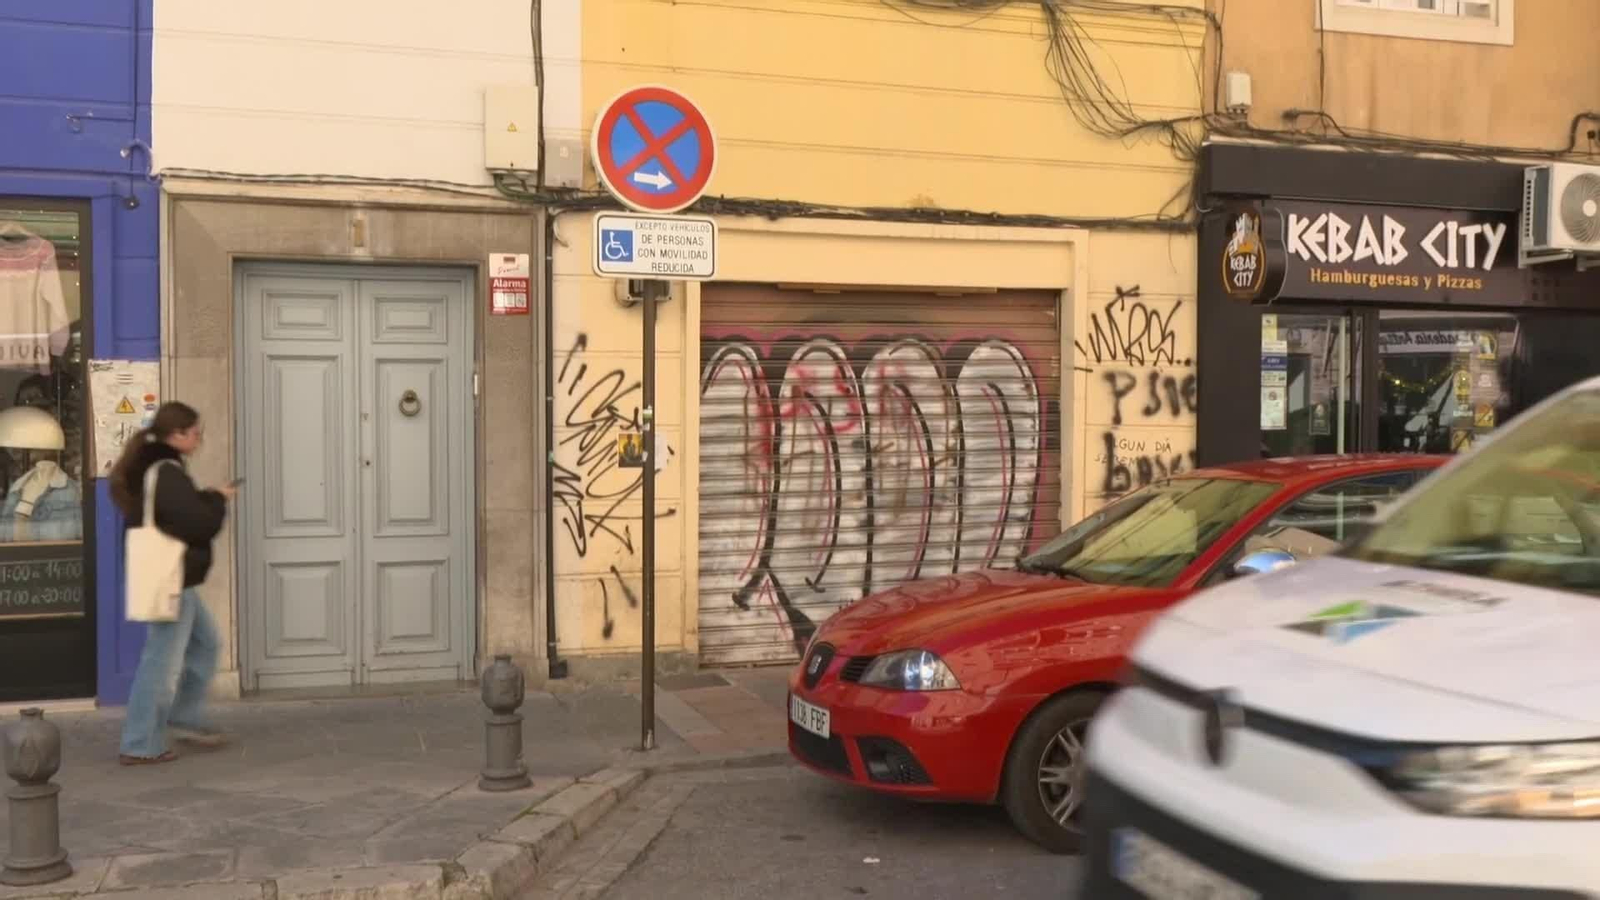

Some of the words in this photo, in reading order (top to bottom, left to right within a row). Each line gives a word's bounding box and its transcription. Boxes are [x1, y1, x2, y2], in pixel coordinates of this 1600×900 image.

[635, 220, 668, 231] EXCEPTO
[641, 234, 653, 244] DE
[657, 235, 704, 247] PERSONAS
[1287, 211, 1408, 266] KEBAB
[1419, 220, 1507, 272] CITY
[637, 248, 656, 258] CON
[660, 249, 708, 260] MOVILIDAD
[651, 262, 694, 274] REDUCIDA
[1230, 254, 1257, 271] KEBAB
[493, 278, 527, 289] Alarma
[1233, 270, 1254, 288] CITY
[1310, 268, 1419, 290] Hamburguesas
[1423, 275, 1433, 291] y
[1437, 274, 1483, 290] Pizzas
